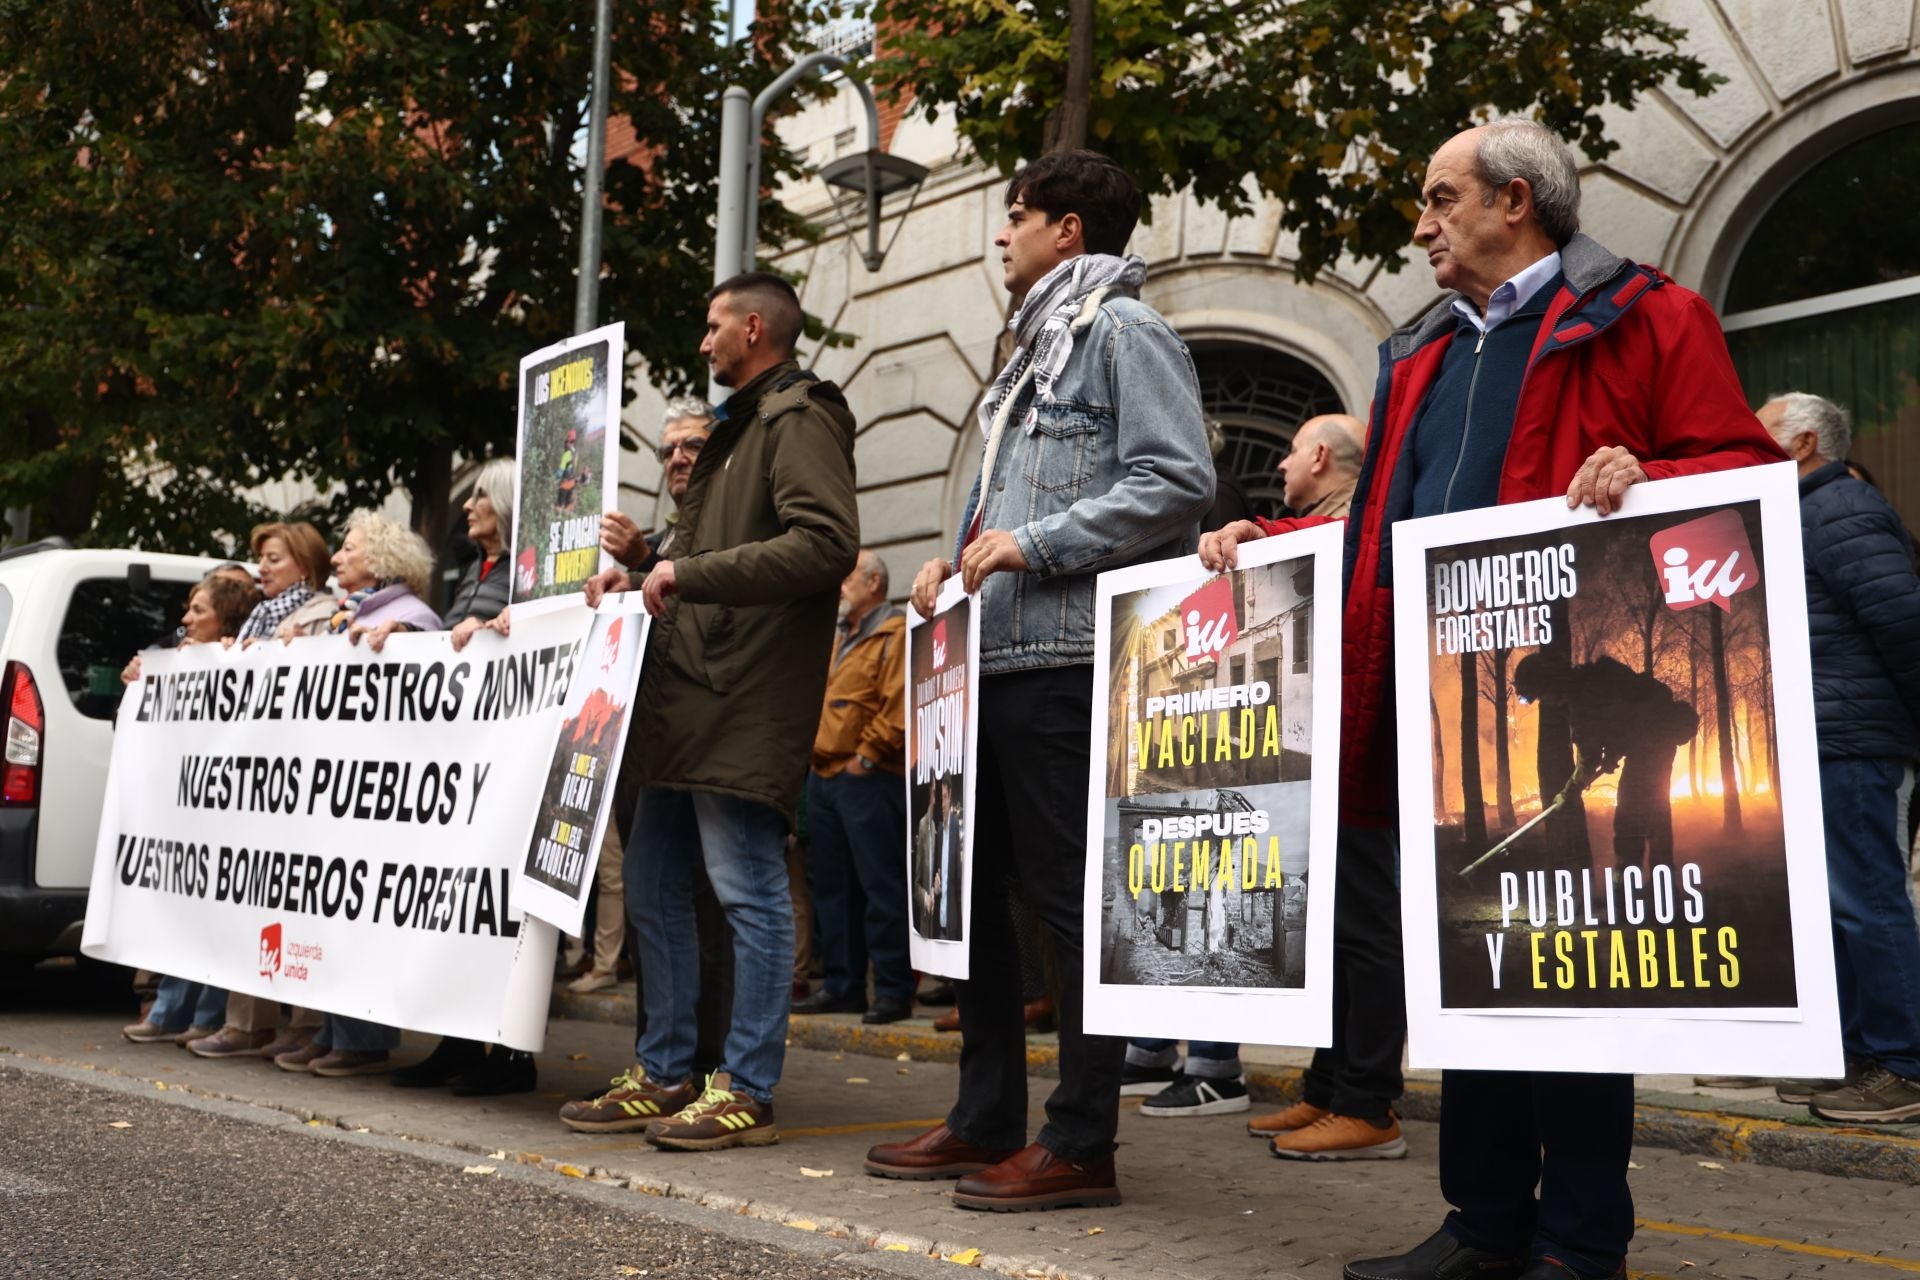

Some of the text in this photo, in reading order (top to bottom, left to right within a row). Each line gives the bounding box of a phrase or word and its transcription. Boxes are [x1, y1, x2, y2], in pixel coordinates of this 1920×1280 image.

[534, 372, 550, 406] LOS
[549, 521, 561, 553] SE
[1434, 543, 1577, 615] BOMBEROS
[1662, 546, 1746, 605] iu
[1184, 610, 1231, 660] iu
[1435, 604, 1553, 656] FORESTALES
[136, 638, 582, 722] EN DEFENSA DE NUESTROS MONTES
[1145, 681, 1270, 719] PRIMERO
[1136, 705, 1280, 771] VACIADA
[176, 754, 491, 826] NUESTROS PUEBLOS Y
[1142, 810, 1270, 841] DESPUES
[215, 846, 368, 921] BOMBEROS
[1128, 836, 1282, 900] QUEMADA
[1499, 862, 1704, 928] PUBLICOS
[284, 961, 308, 981] unida
[287, 941, 323, 961] izquierda
[1485, 926, 1741, 990] Y ESTABLES
